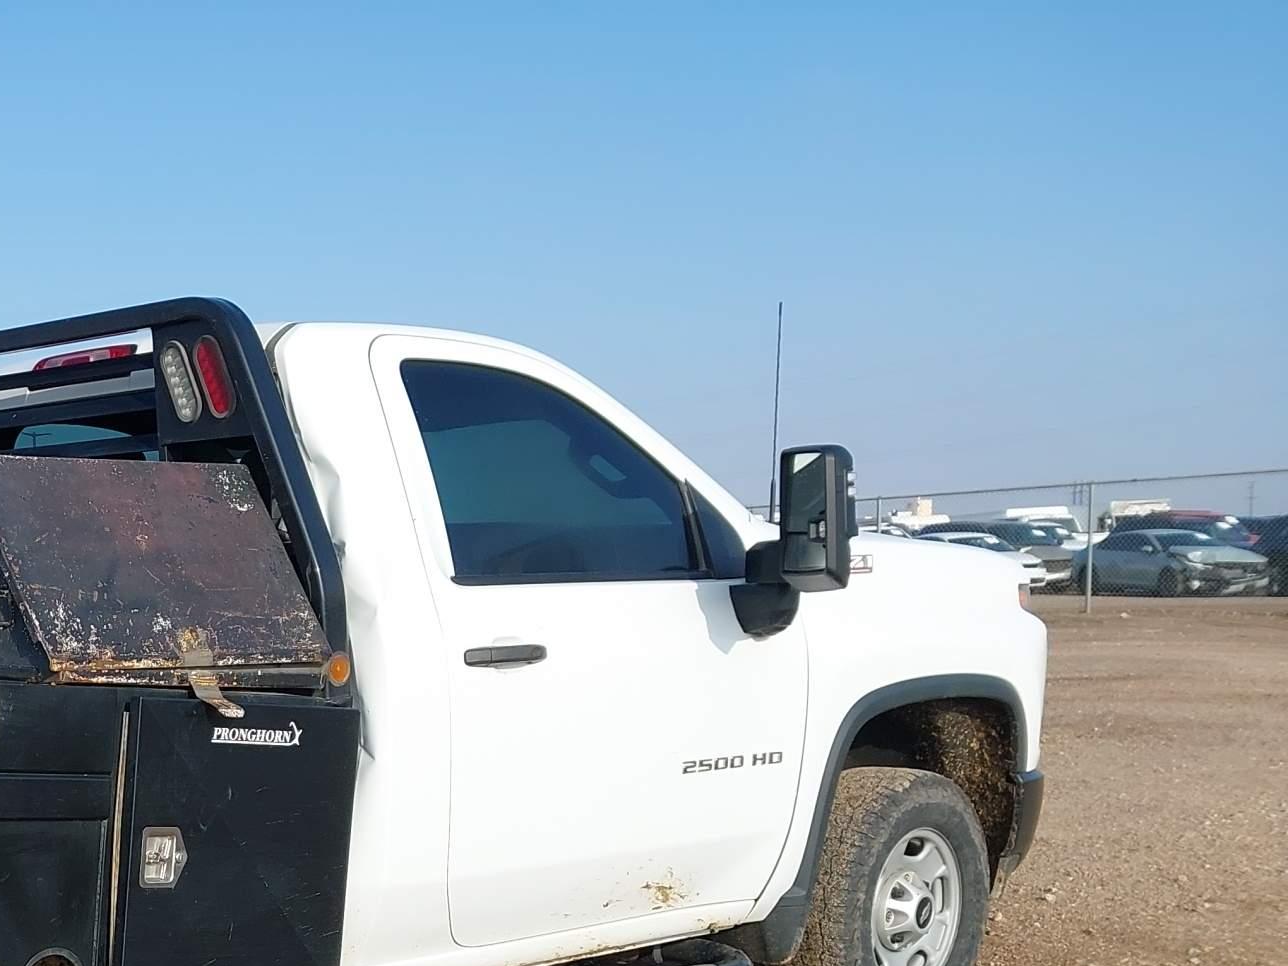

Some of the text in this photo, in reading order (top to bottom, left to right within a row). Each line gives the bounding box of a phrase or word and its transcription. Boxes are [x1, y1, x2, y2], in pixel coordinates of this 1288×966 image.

[212, 727, 293, 744] PRONGHORN
[682, 752, 783, 774] 2500 HD
